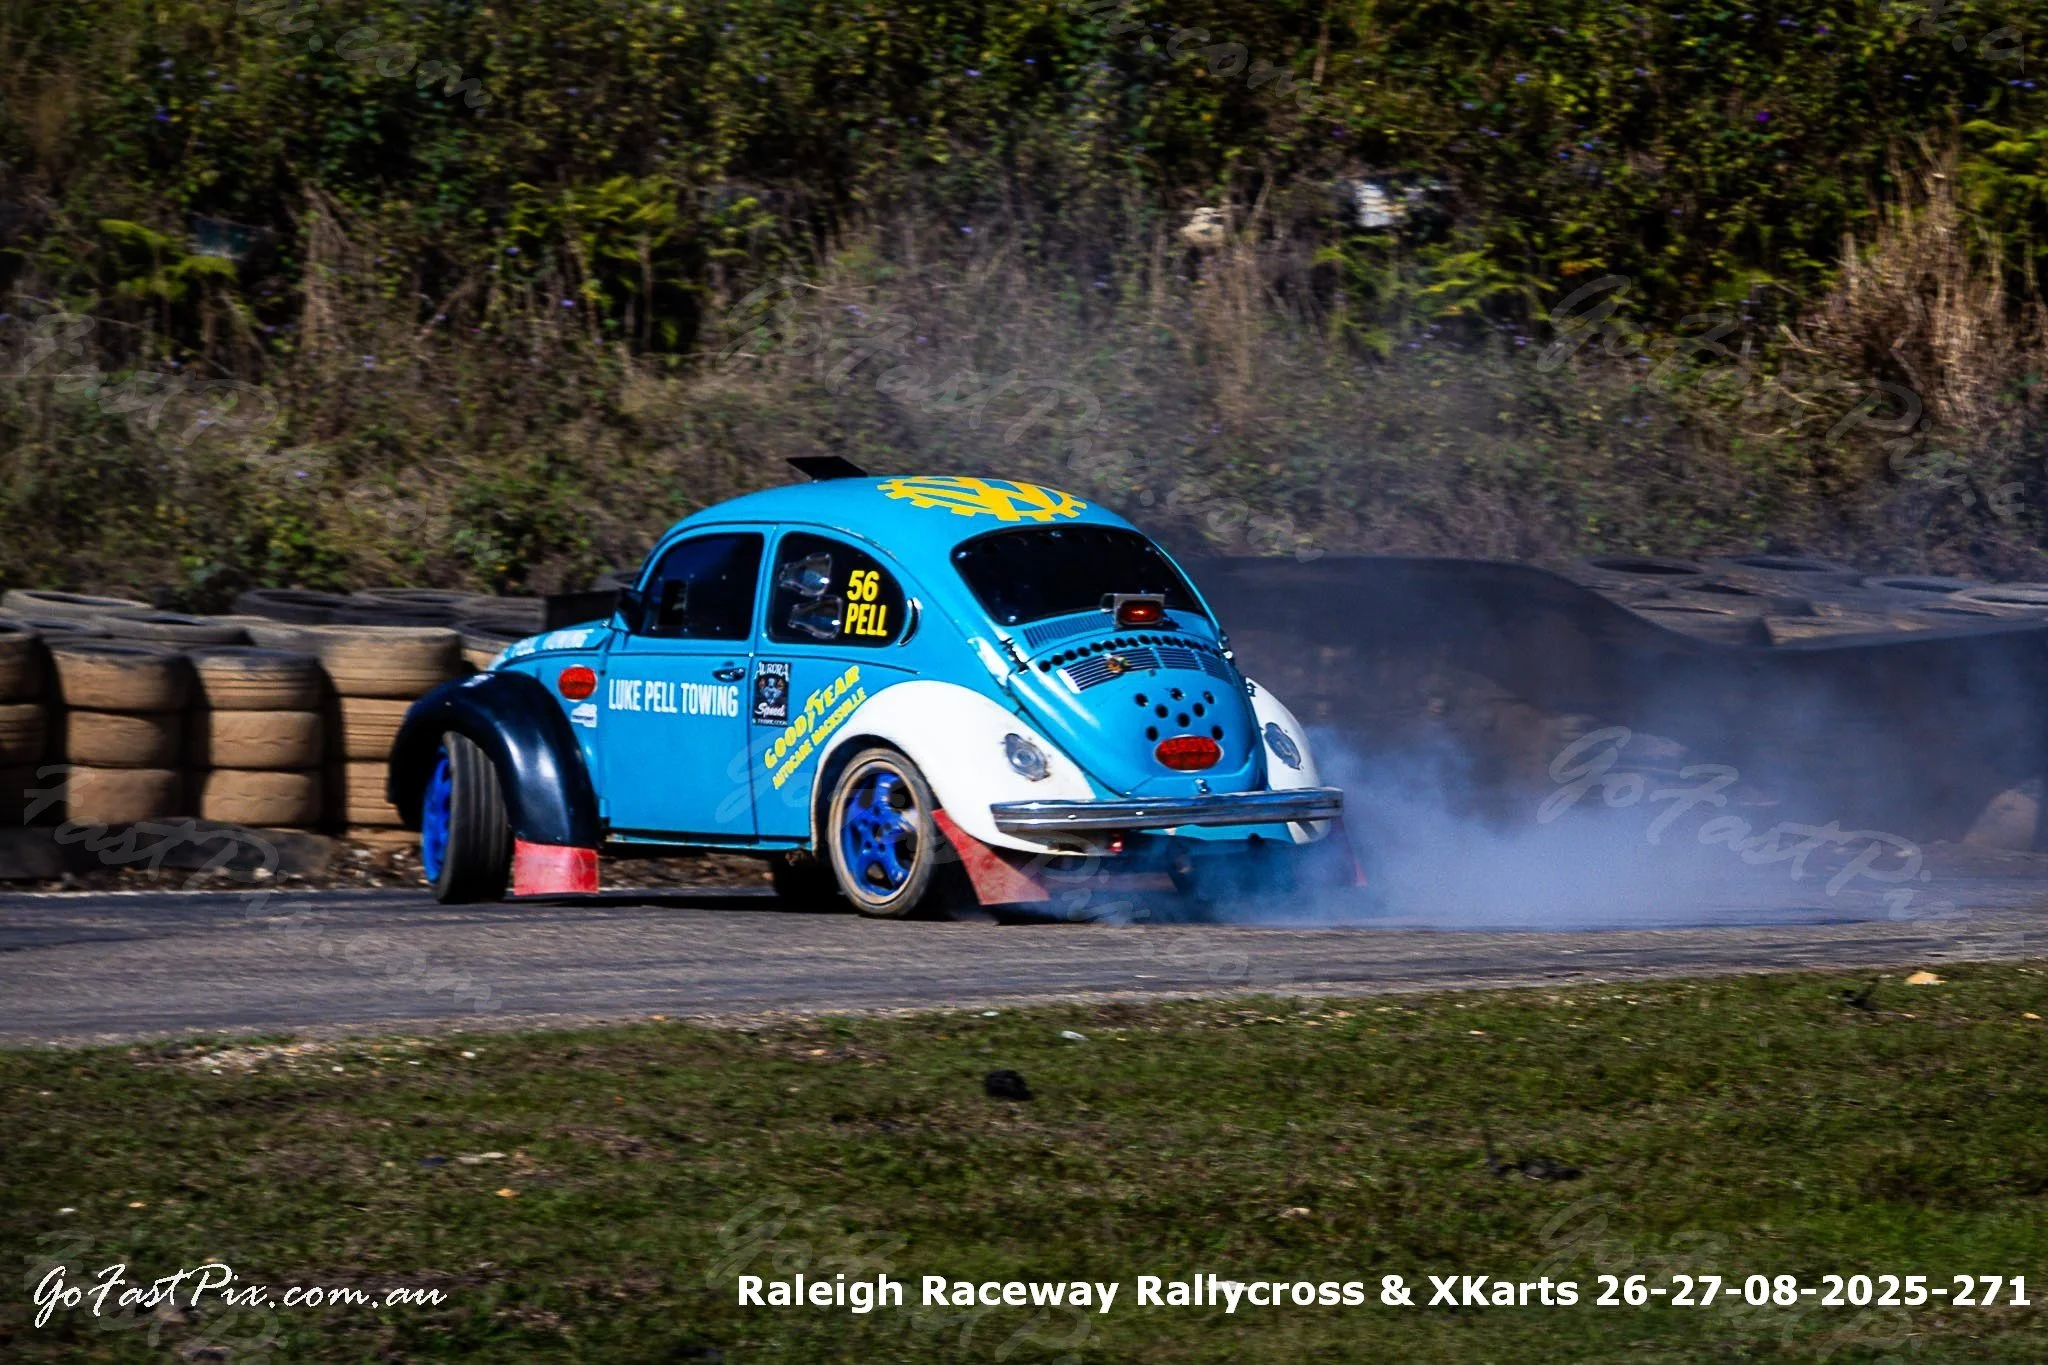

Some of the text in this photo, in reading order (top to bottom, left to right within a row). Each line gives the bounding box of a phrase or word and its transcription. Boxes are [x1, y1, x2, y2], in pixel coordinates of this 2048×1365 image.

[846, 569, 880, 602] 56
[844, 602, 888, 637] PELL
[753, 661, 790, 682] AURORA
[608, 679, 739, 717] LUKE PELL TOWING
